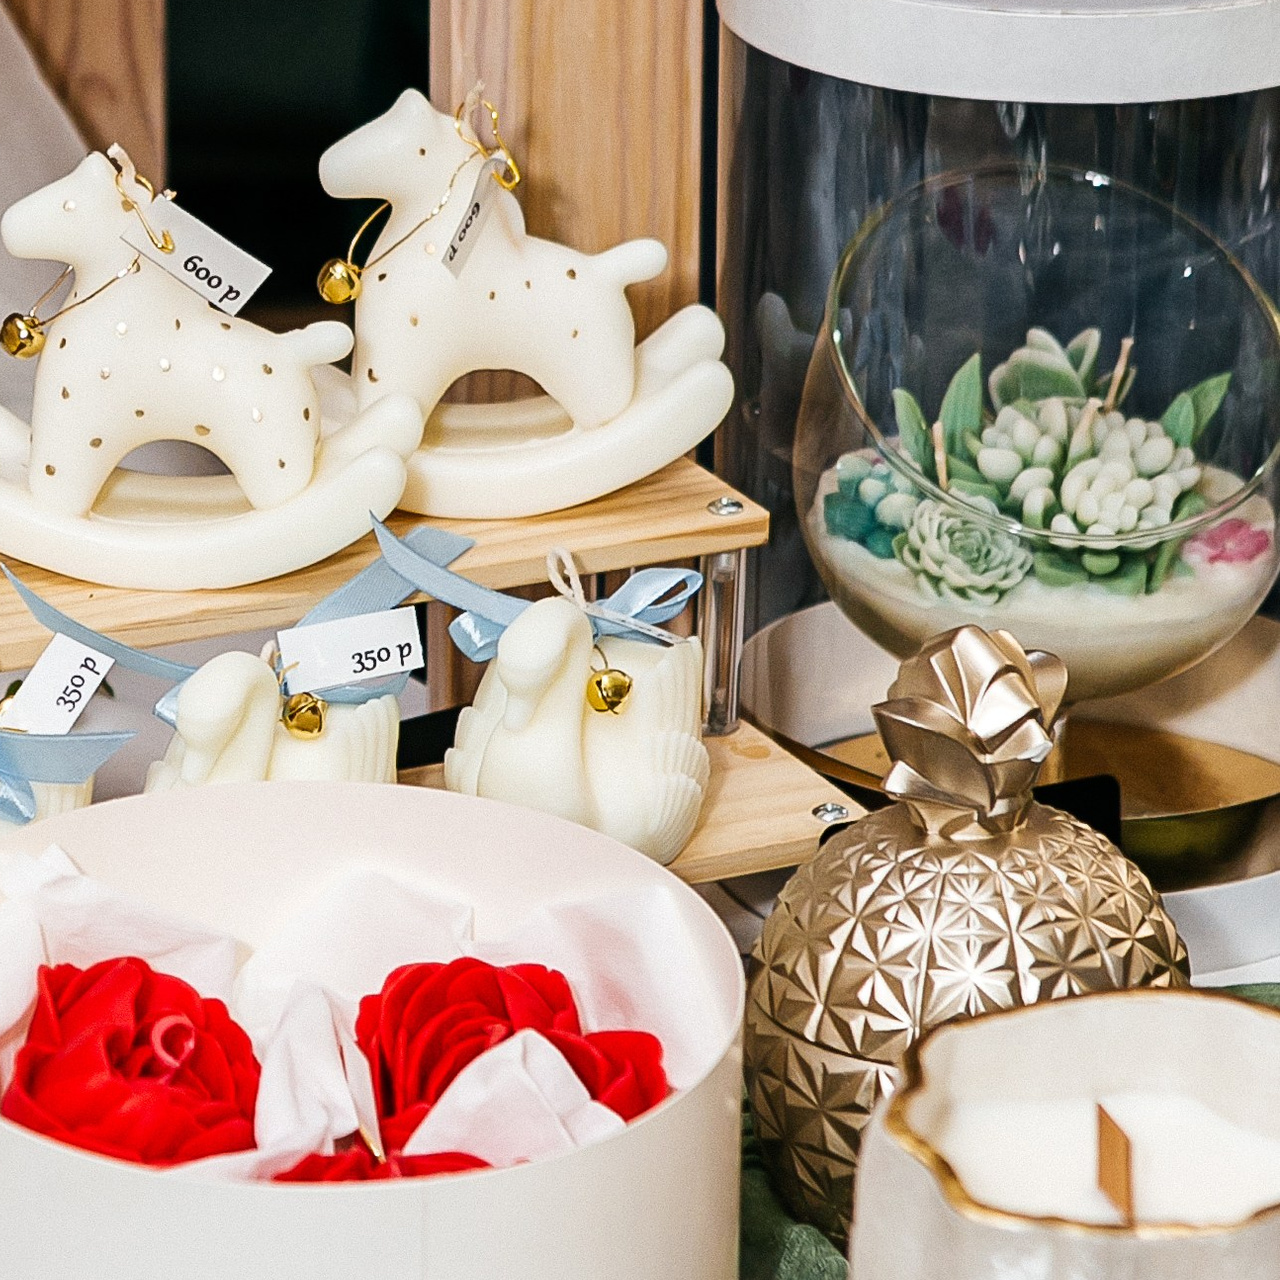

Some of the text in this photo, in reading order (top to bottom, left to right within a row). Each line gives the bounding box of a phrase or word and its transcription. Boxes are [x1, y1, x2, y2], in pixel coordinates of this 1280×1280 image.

[459, 202, 480, 242] 600
[183, 255, 241, 303] 600 р
[352, 642, 412, 674] 350 р
[56, 656, 101, 713] 350 р
